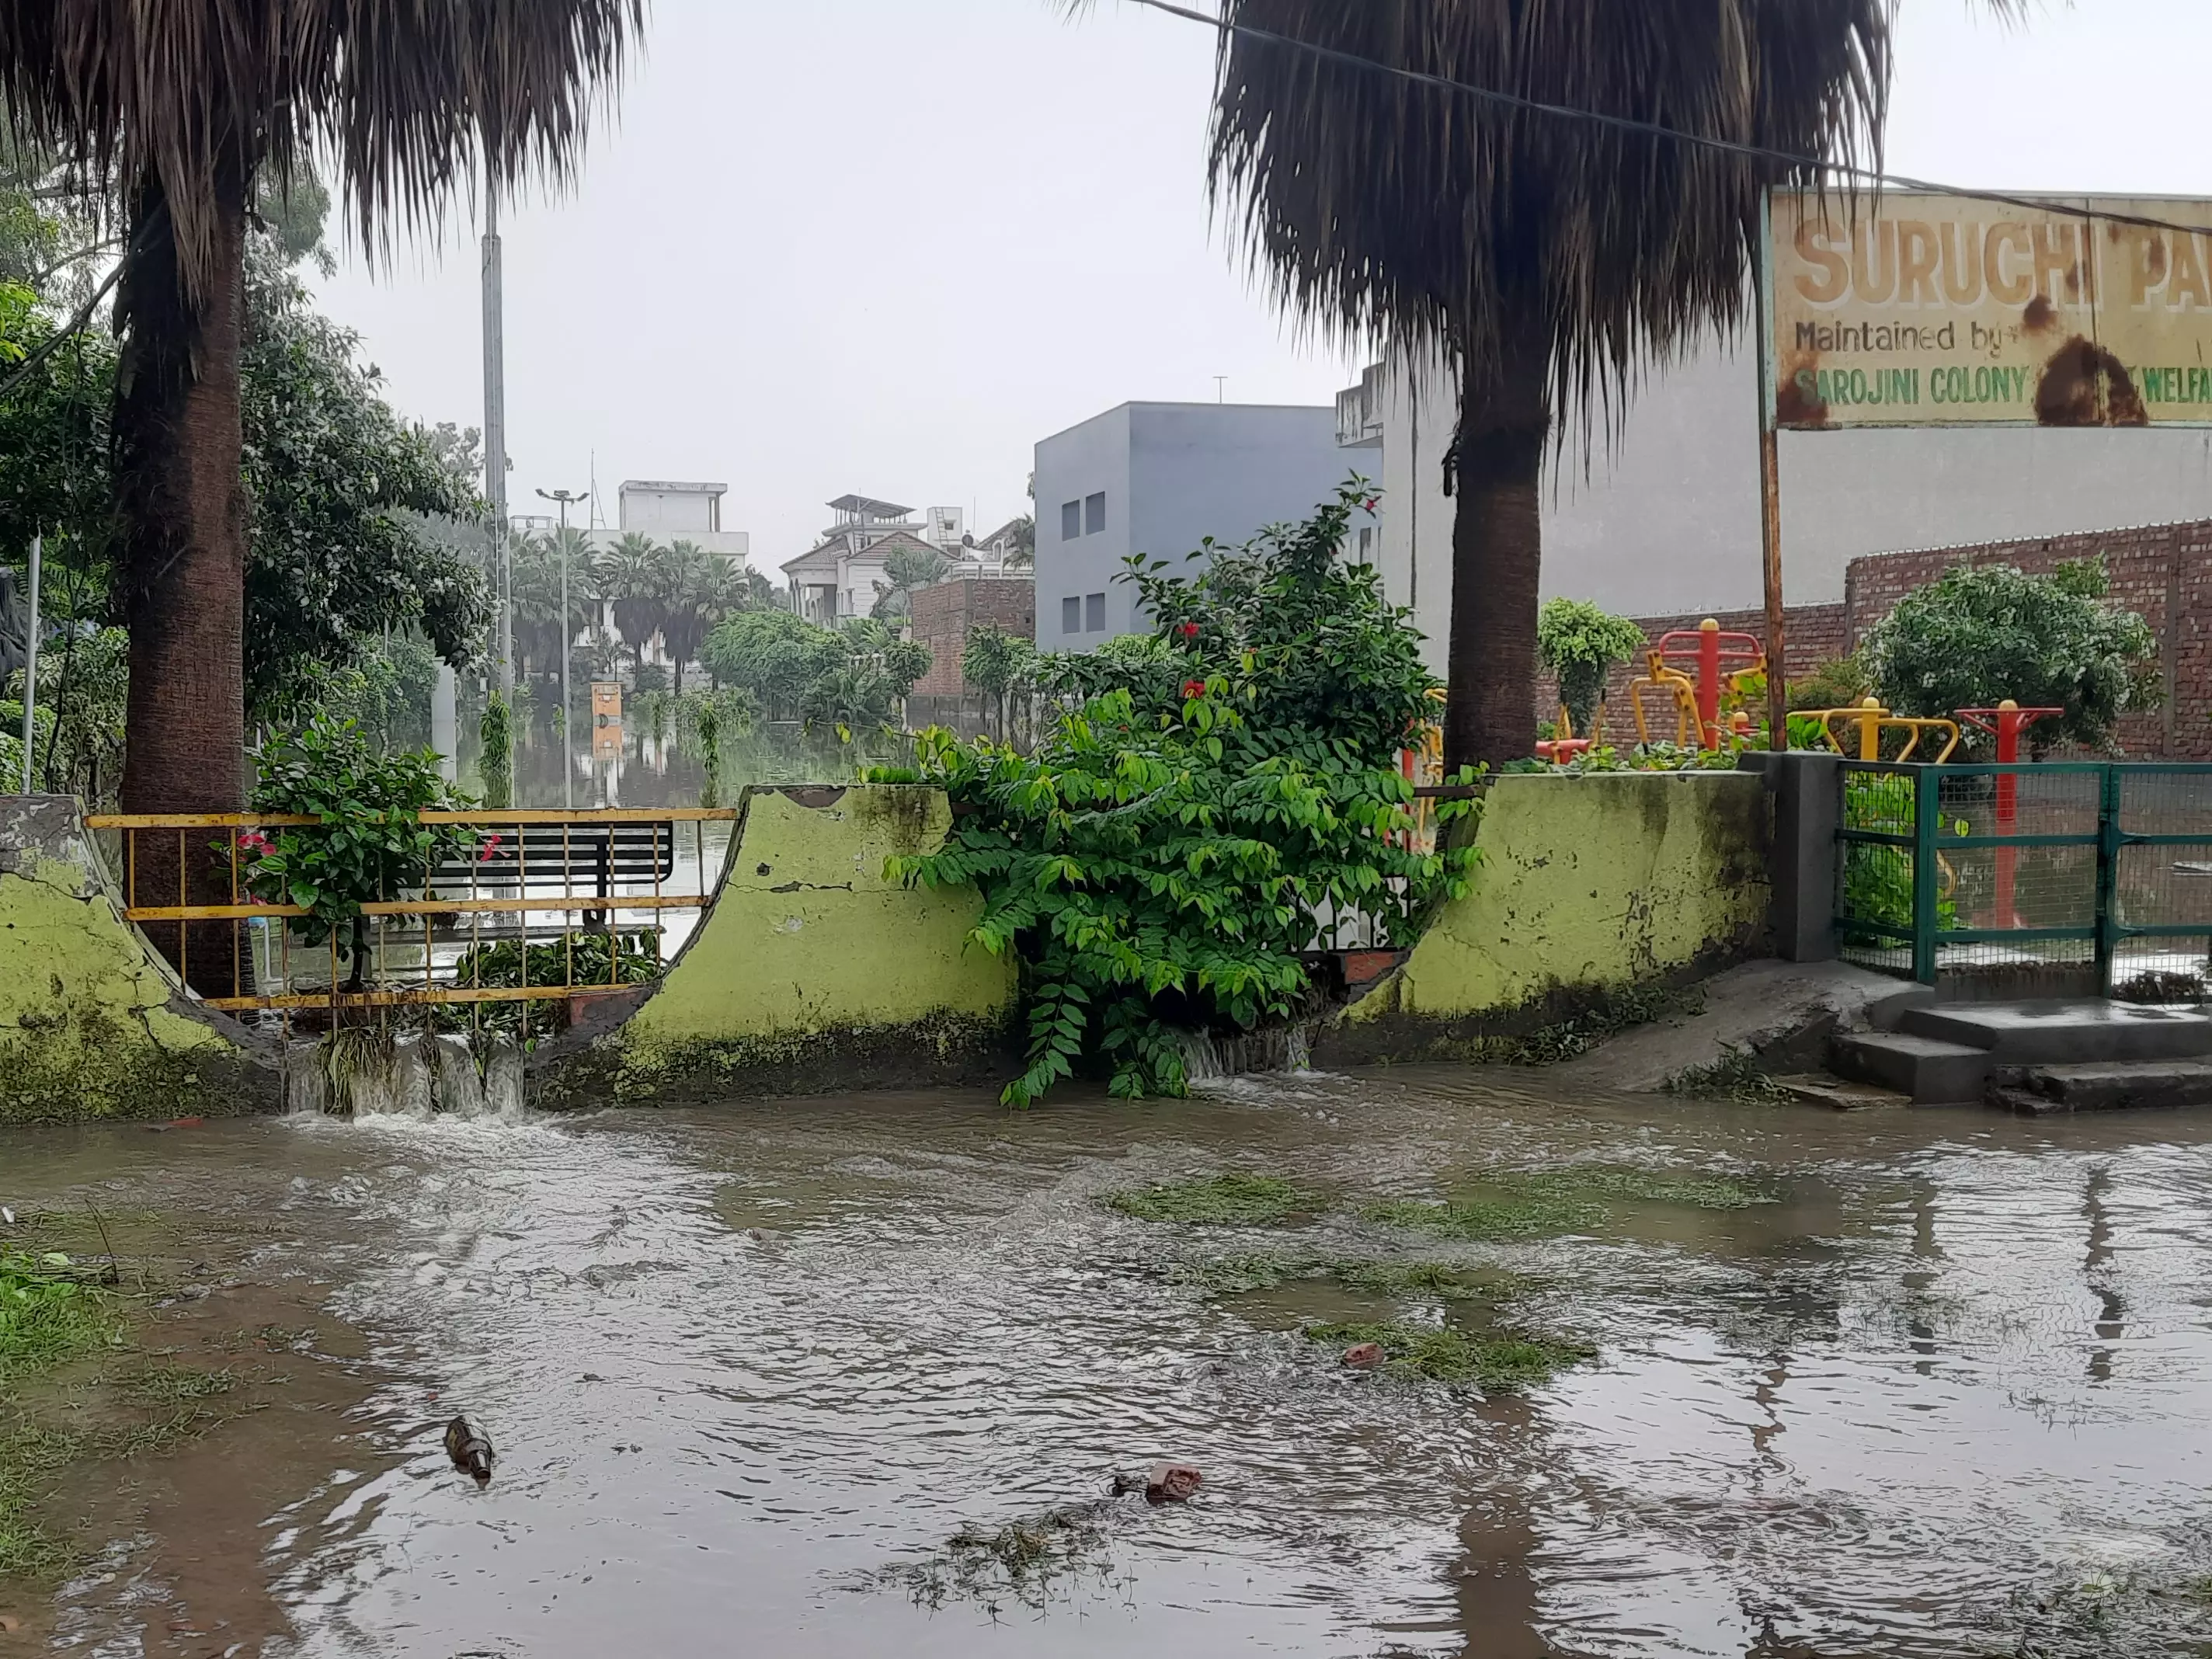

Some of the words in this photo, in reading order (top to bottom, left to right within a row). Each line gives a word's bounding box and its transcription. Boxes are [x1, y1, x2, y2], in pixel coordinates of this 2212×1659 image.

[1793, 218, 2102, 308] SURUCHI
[2129, 222, 2212, 310] PA
[1795, 321, 1955, 352] Maintained
[1795, 367, 1920, 405] SAROJINI
